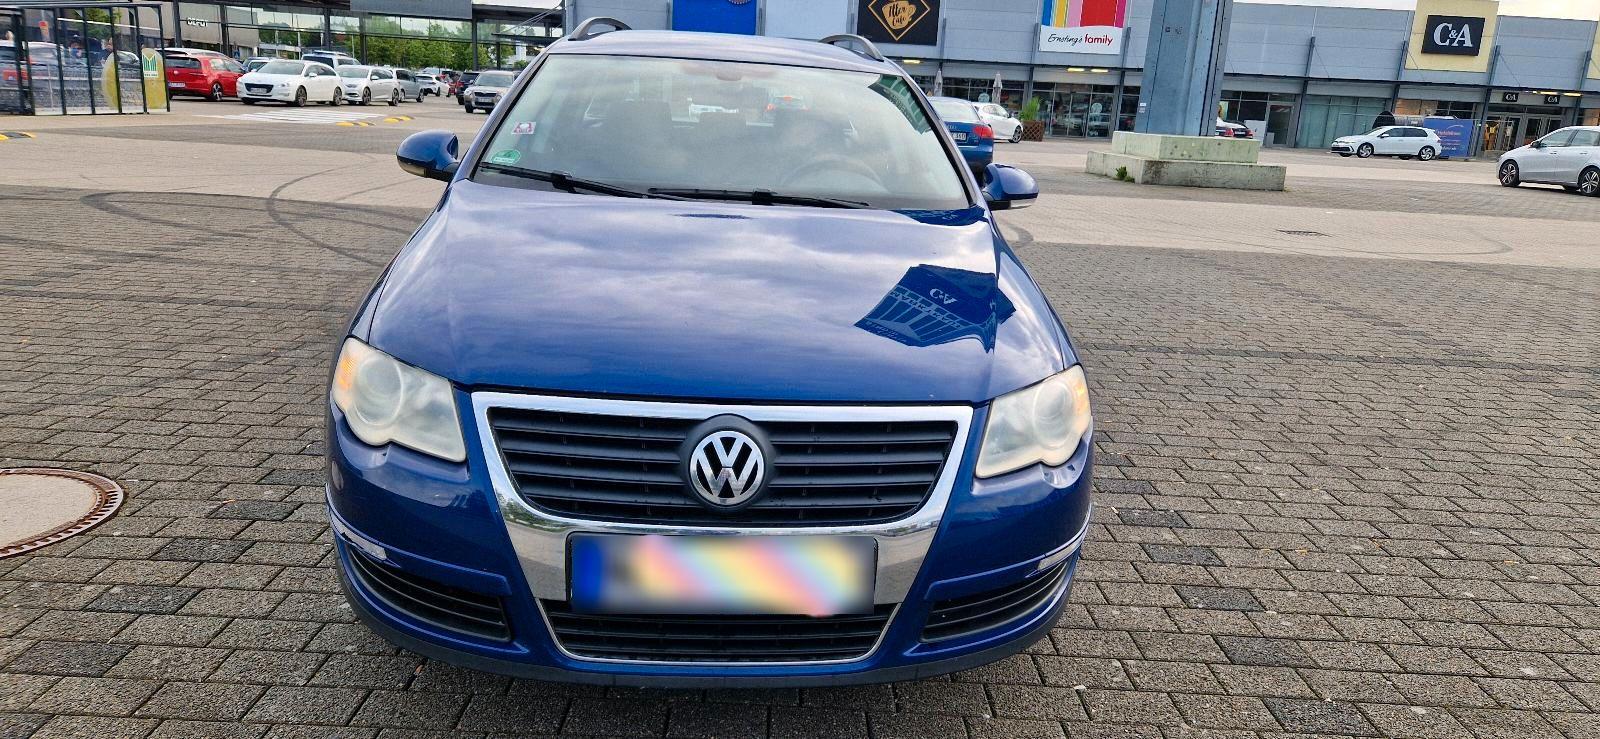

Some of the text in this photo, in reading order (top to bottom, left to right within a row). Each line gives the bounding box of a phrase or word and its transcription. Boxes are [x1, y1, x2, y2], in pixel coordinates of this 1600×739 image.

[1084, 33, 1113, 46] family
[1433, 22, 1473, 47] C&A
[691, 432, 763, 504] VW
